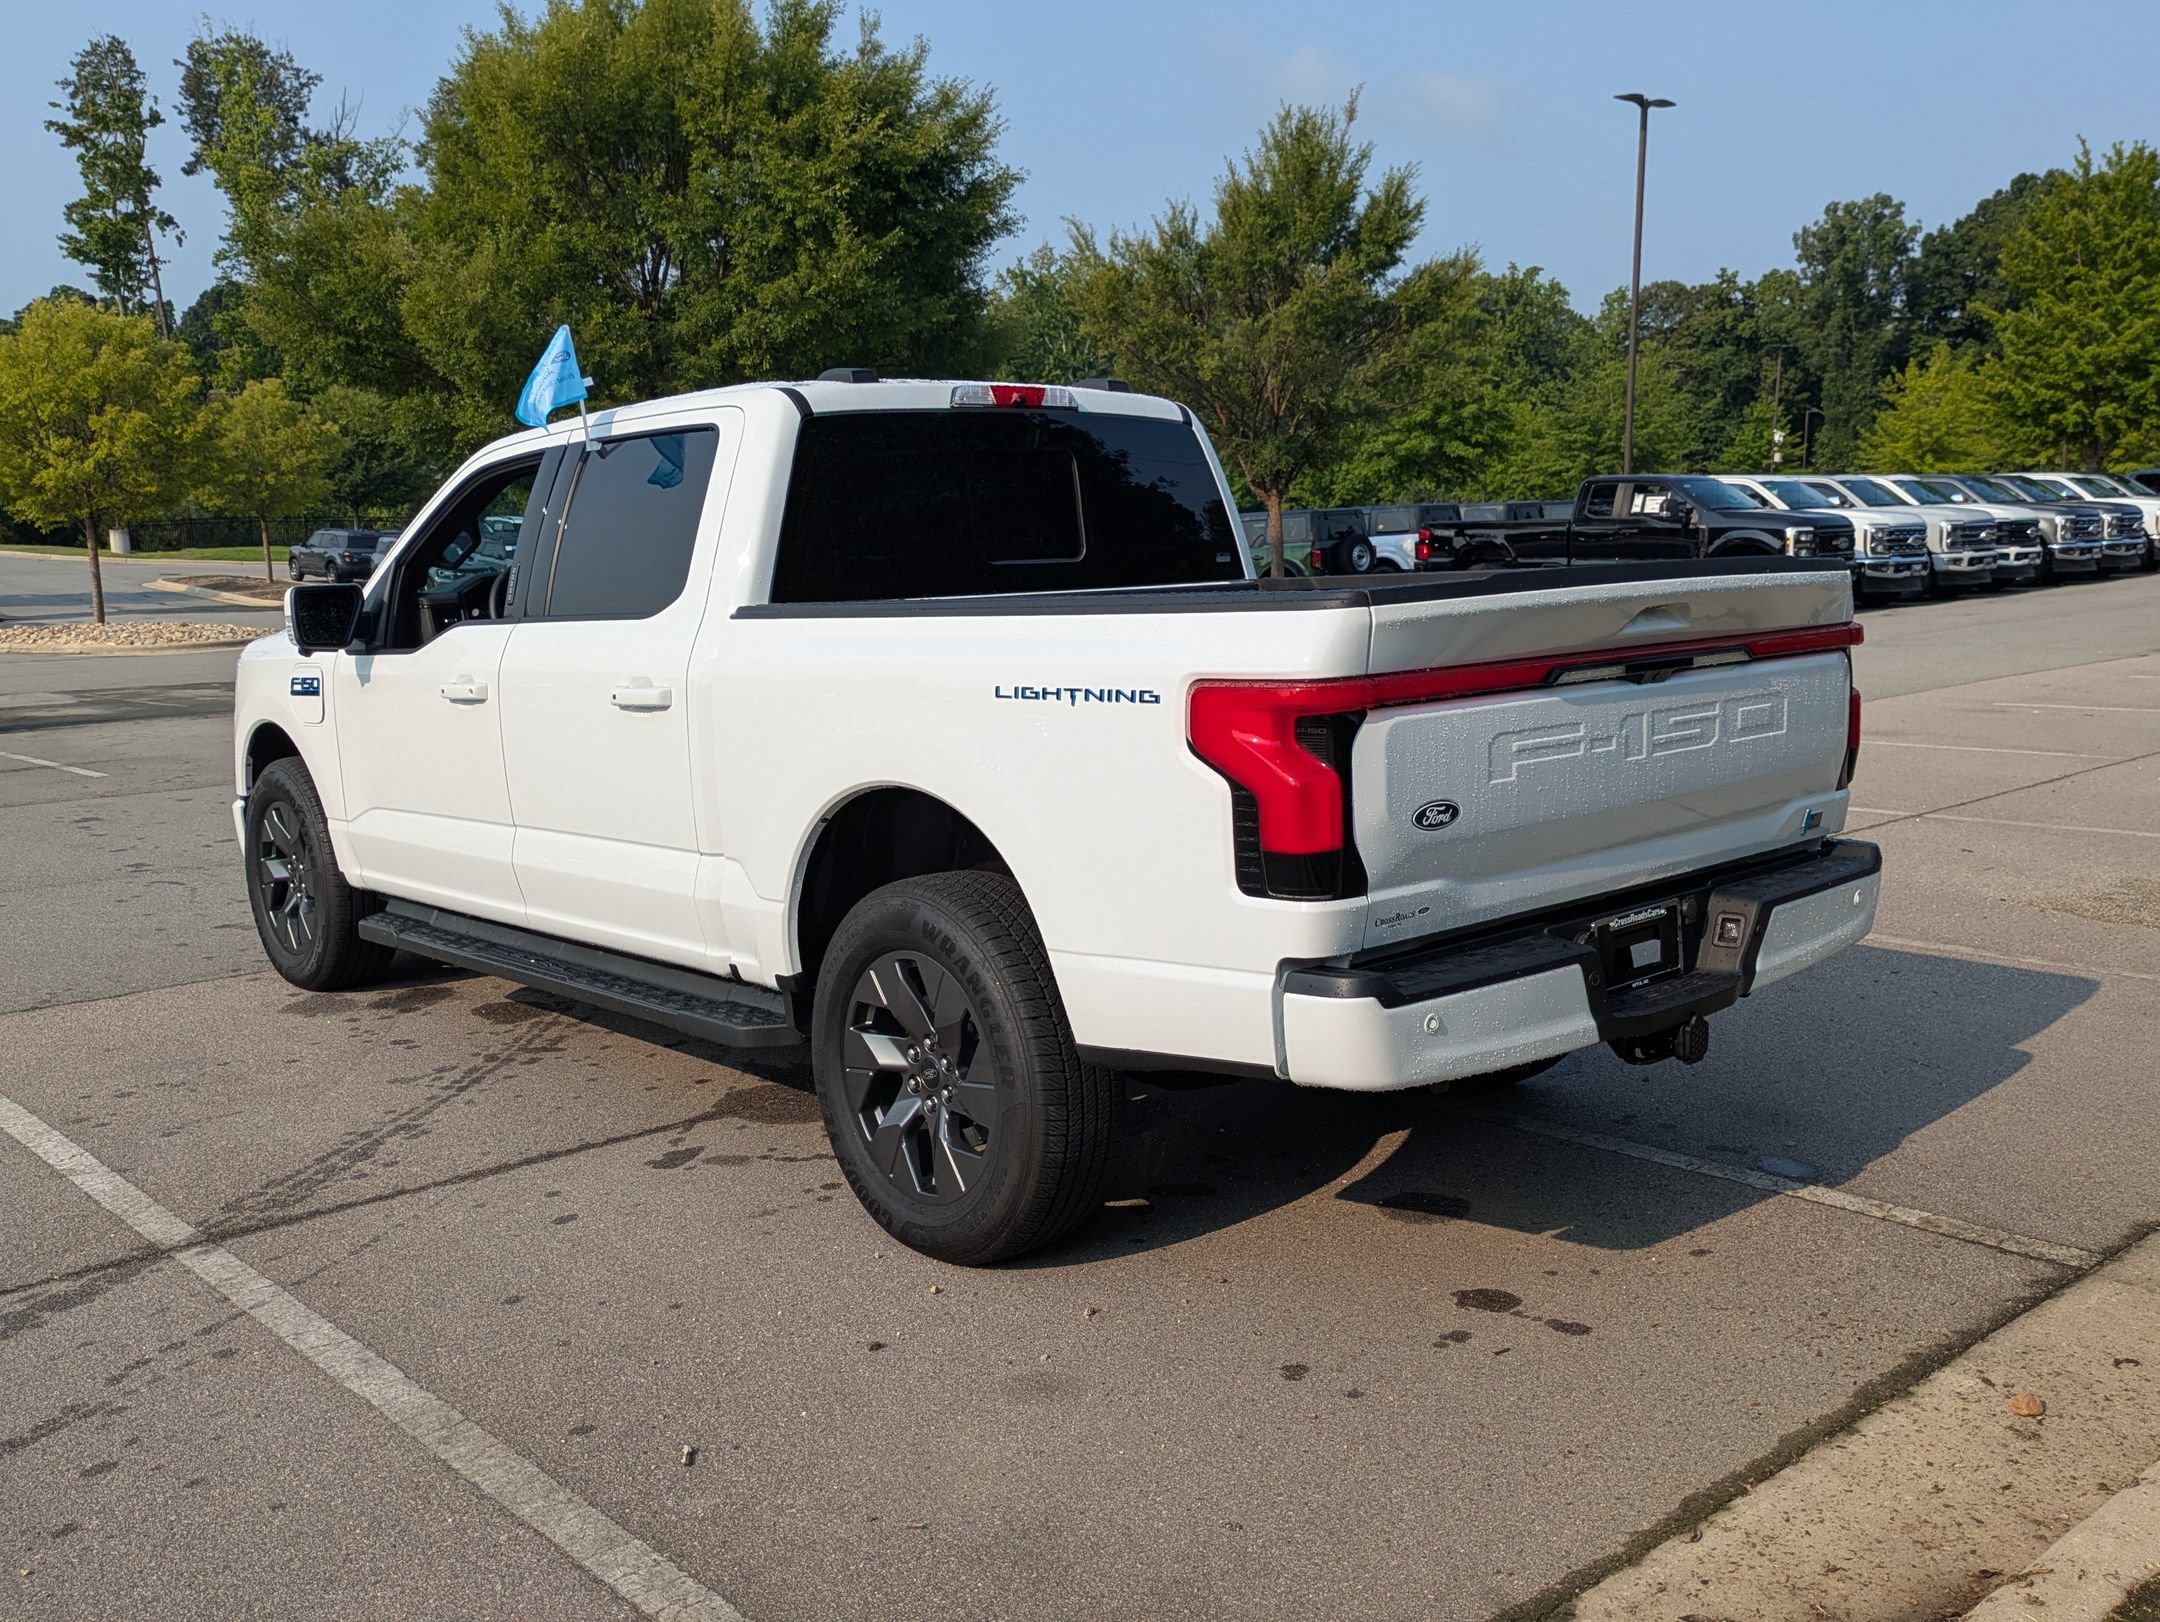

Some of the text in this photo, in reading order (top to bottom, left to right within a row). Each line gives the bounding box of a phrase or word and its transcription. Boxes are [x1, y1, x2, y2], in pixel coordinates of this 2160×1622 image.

[995, 685, 1161, 707] LIGHTNING
[1487, 692, 1789, 784] F-150
[920, 919, 1017, 1090] WRANGLER
